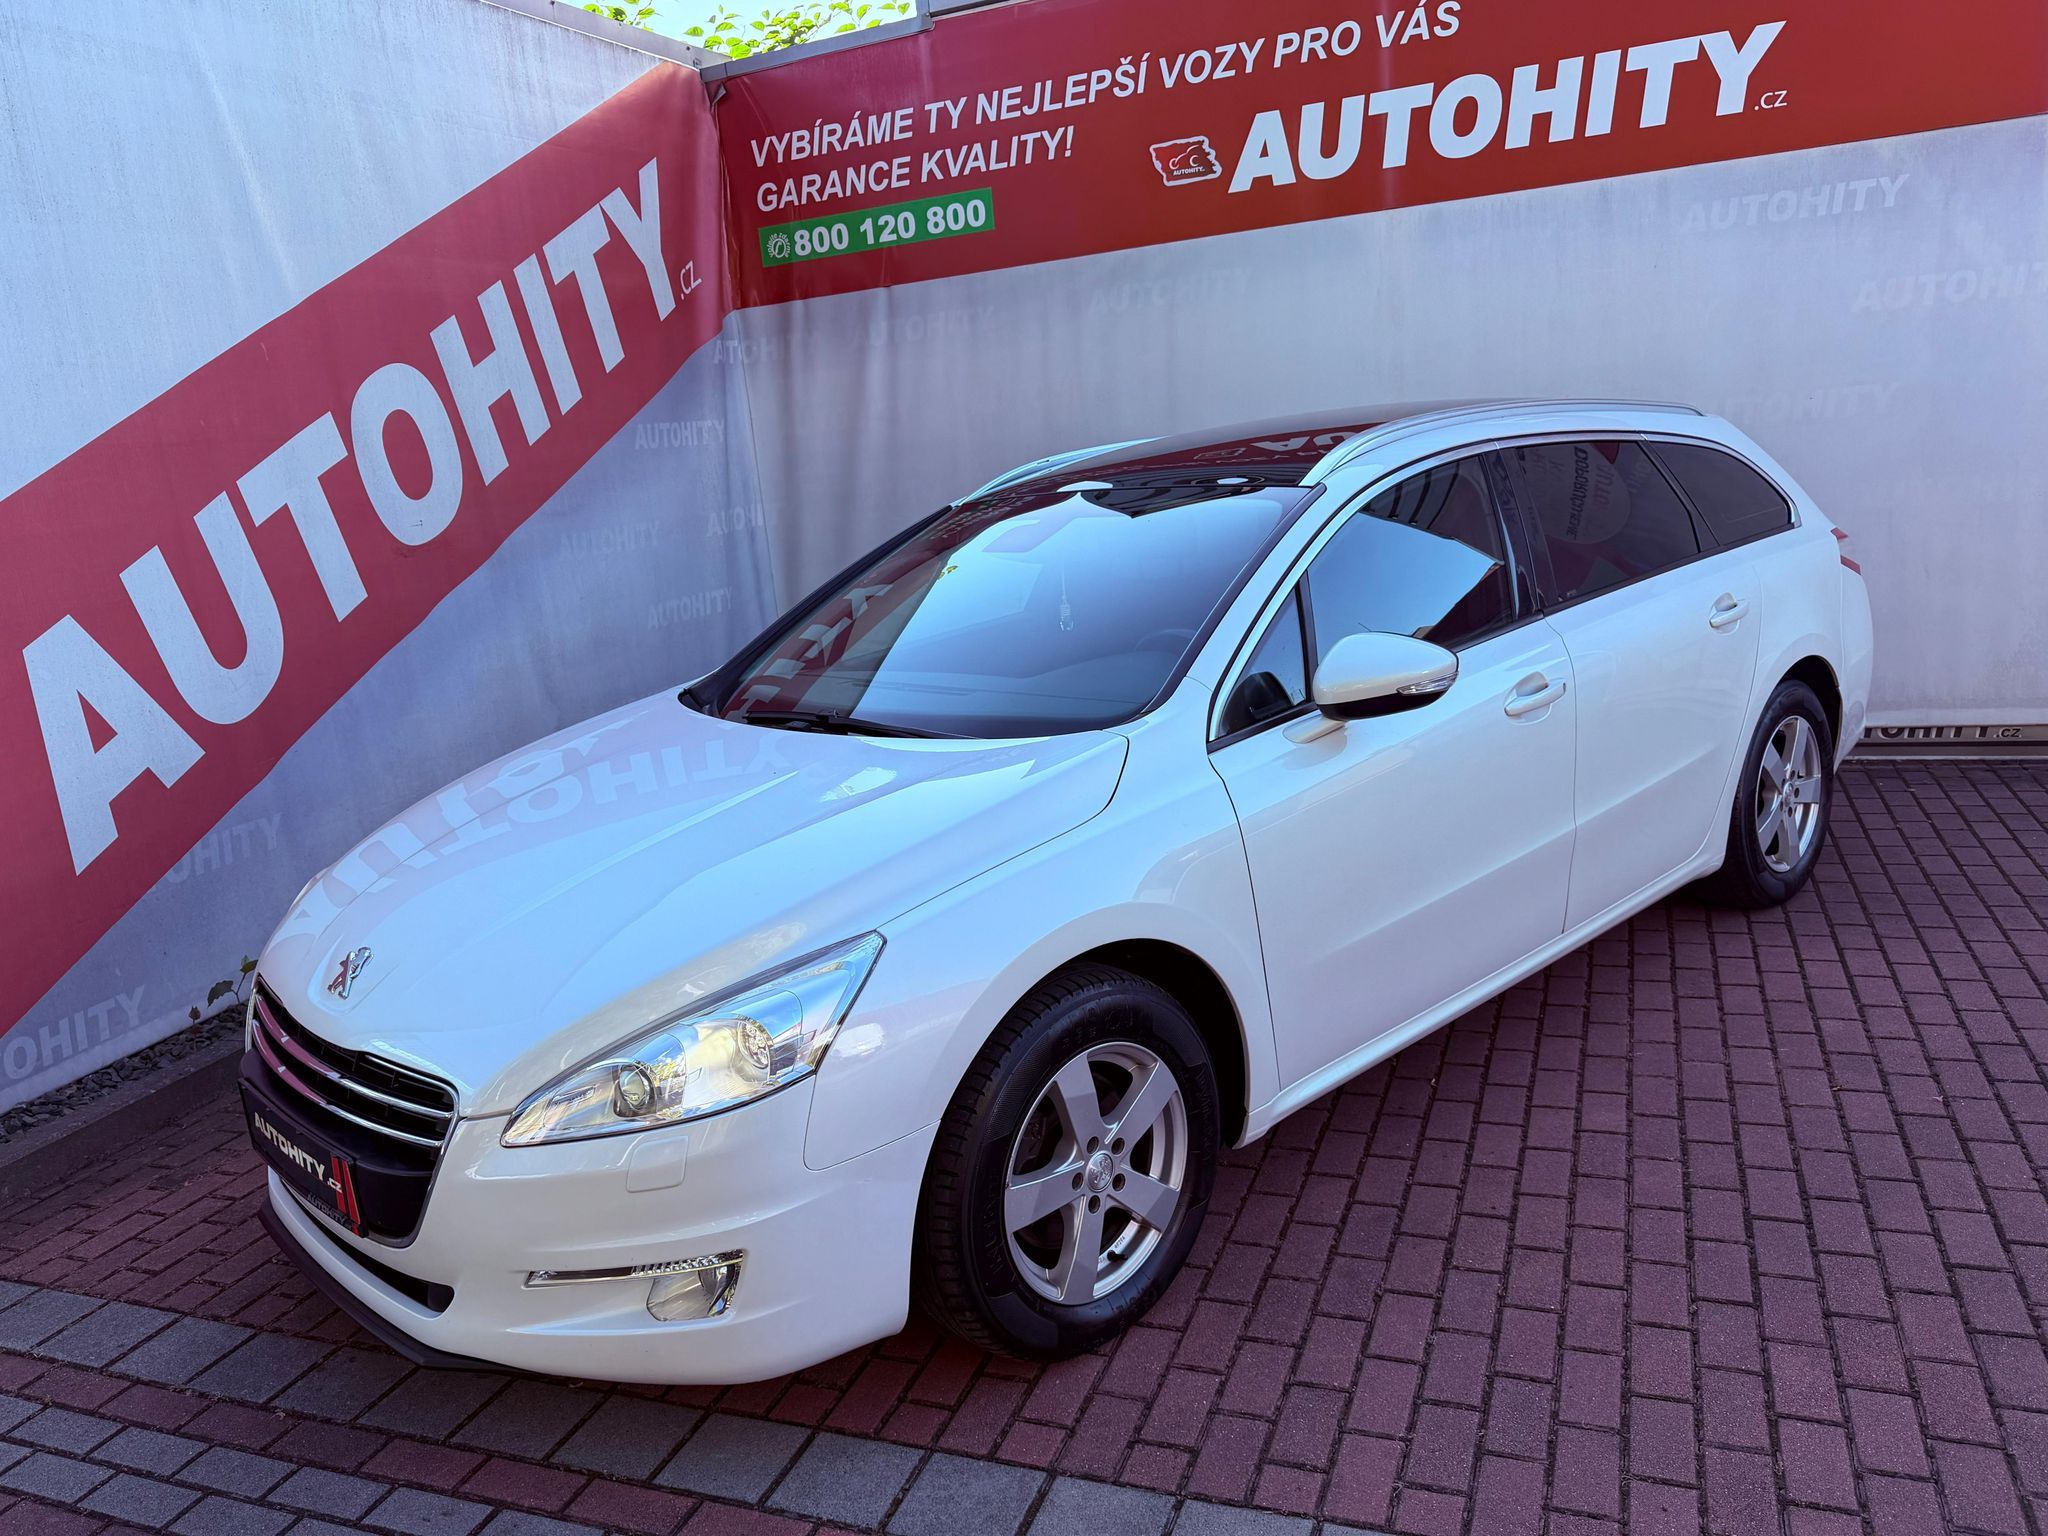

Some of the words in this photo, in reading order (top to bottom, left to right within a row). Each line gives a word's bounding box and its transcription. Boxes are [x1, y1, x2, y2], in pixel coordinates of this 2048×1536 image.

[750, 108, 914, 168] VYBÍRÁME
[923, 96, 968, 135] TY
[975, 52, 1152, 125] NEJLEPŠÍ
[1158, 37, 1266, 89] VOZY
[1273, 20, 1362, 69] PRO
[1375, 0, 1462, 48] VÁS
[756, 153, 912, 212] GARANCE
[920, 125, 1076, 184] KVALITY!
[1680, 173, 1910, 234] AUTOHITY
[793, 222, 850, 256] 800
[859, 211, 917, 245] 120
[926, 199, 987, 234] 800
